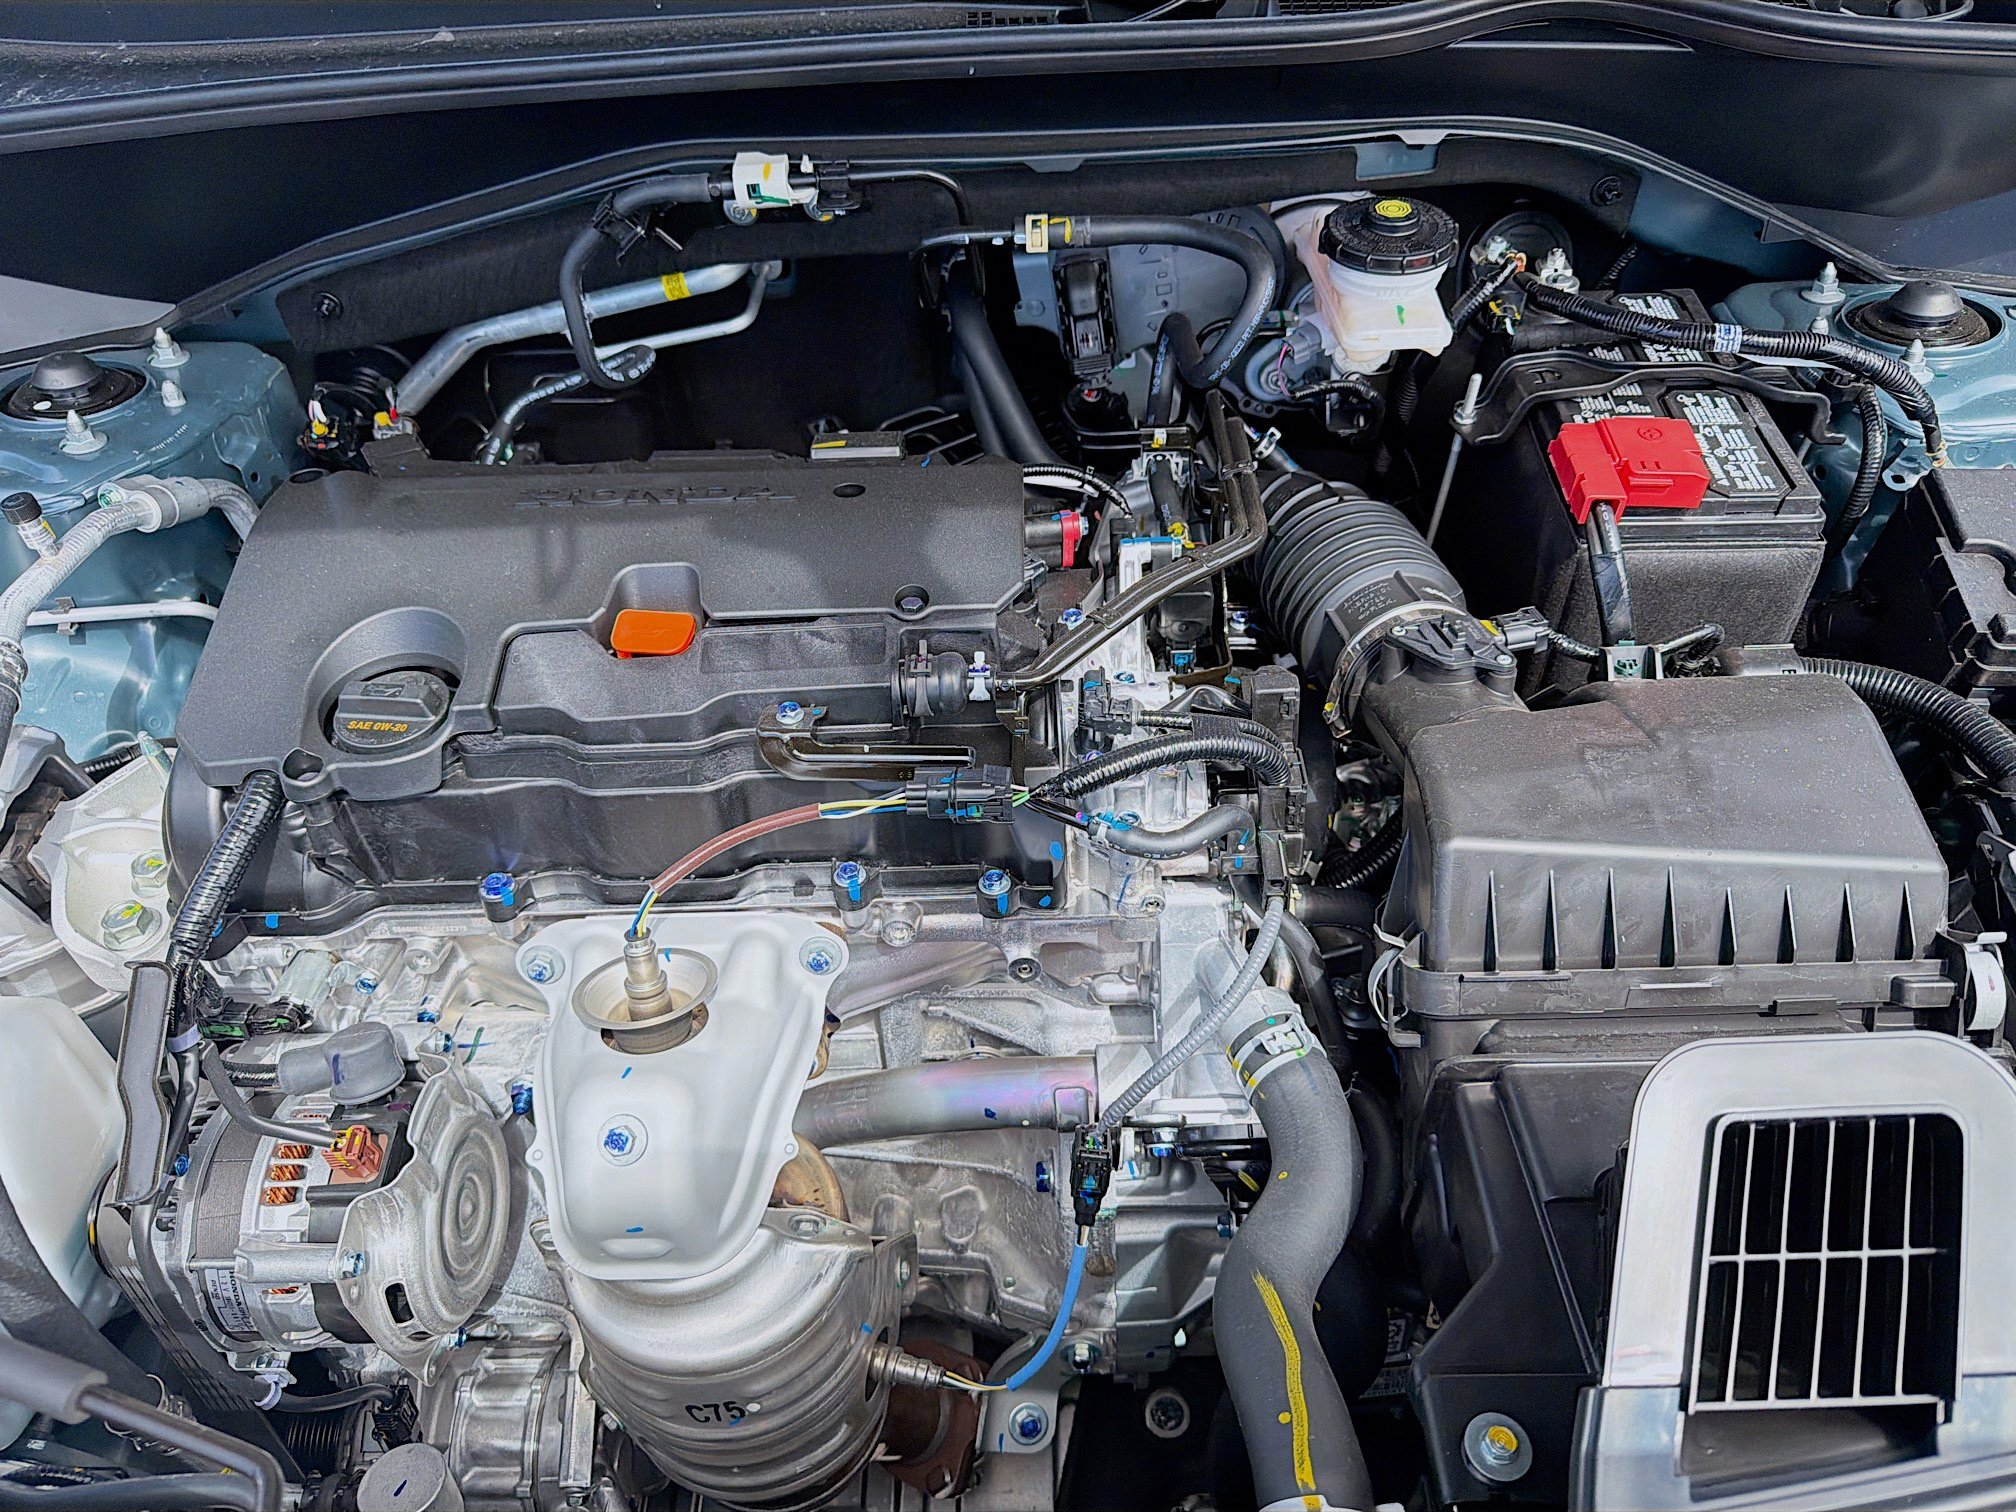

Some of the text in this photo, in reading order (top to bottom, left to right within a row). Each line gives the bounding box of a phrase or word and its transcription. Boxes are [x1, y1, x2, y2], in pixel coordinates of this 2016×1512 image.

[515, 485, 798, 508] HONDA
[347, 720, 409, 733] SAE 0W-20
[210, 1279, 221, 1301] DENSO
[229, 1270, 242, 1308] HONDA
[685, 1400, 746, 1424] C75
